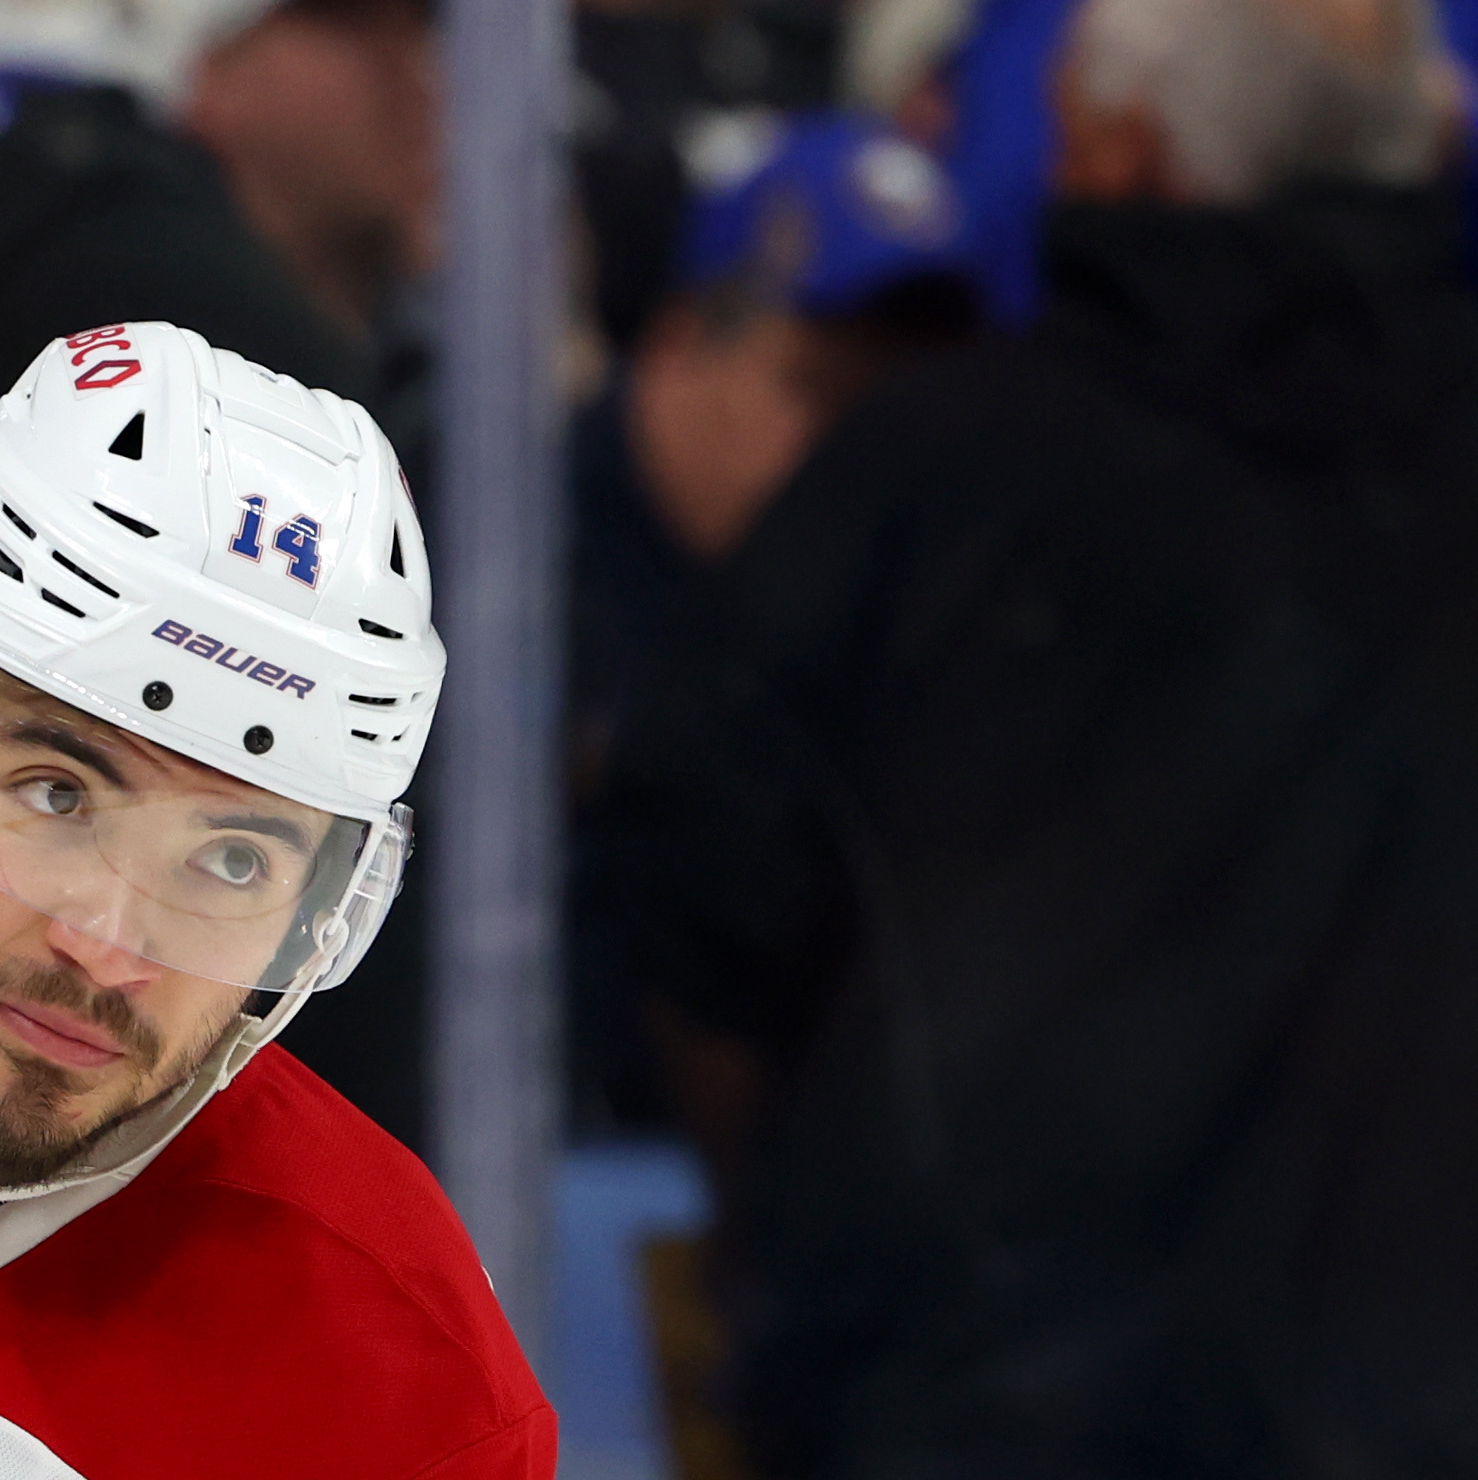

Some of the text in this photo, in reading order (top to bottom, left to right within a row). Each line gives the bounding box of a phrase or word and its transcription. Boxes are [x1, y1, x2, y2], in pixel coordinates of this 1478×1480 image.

[65, 323, 132, 367] BC
[228, 492, 324, 590] 14
[151, 618, 316, 701] BAUER
